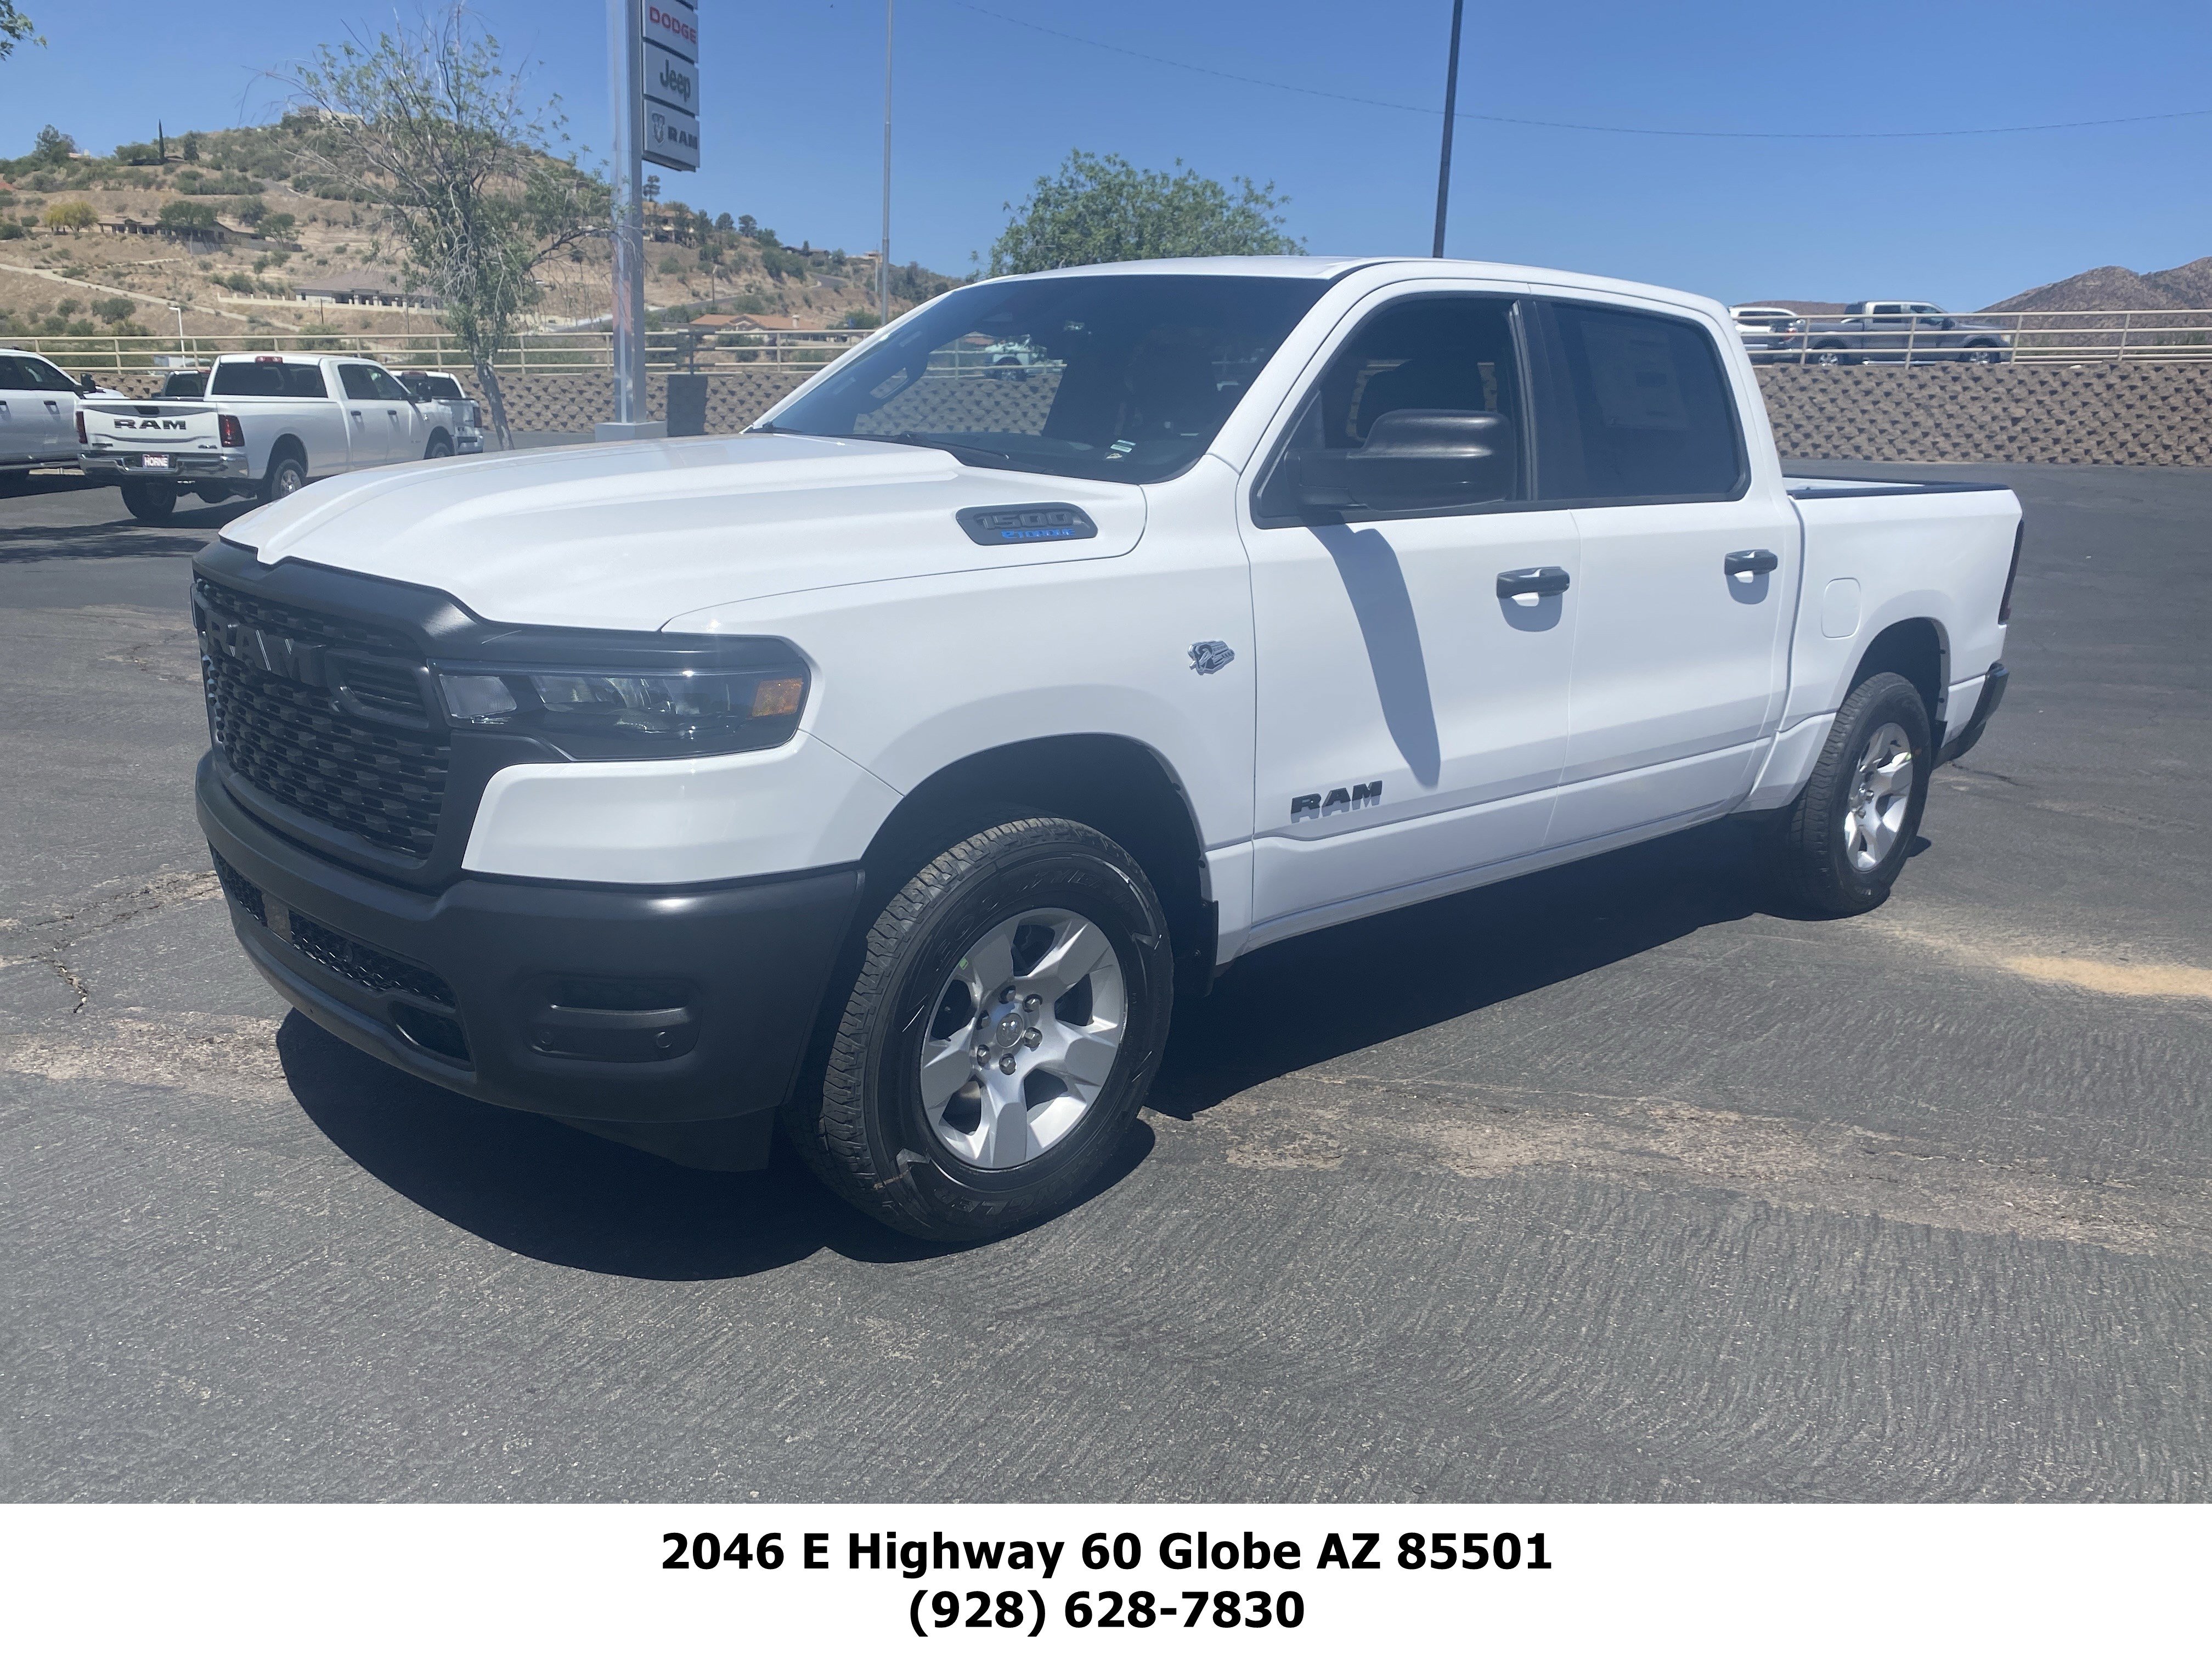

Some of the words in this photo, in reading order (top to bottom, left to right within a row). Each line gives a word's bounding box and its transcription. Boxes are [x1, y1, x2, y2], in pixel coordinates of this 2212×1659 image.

[650, 6, 697, 44] DODGE
[659, 58, 691, 103] Jeep
[667, 126, 698, 150] RAM
[114, 419, 187, 430] RAM
[144, 457, 168, 466] HORNE
[974, 510, 1074, 529] 1500
[205, 609, 326, 689] RAM
[1291, 780, 1383, 814] RAM
